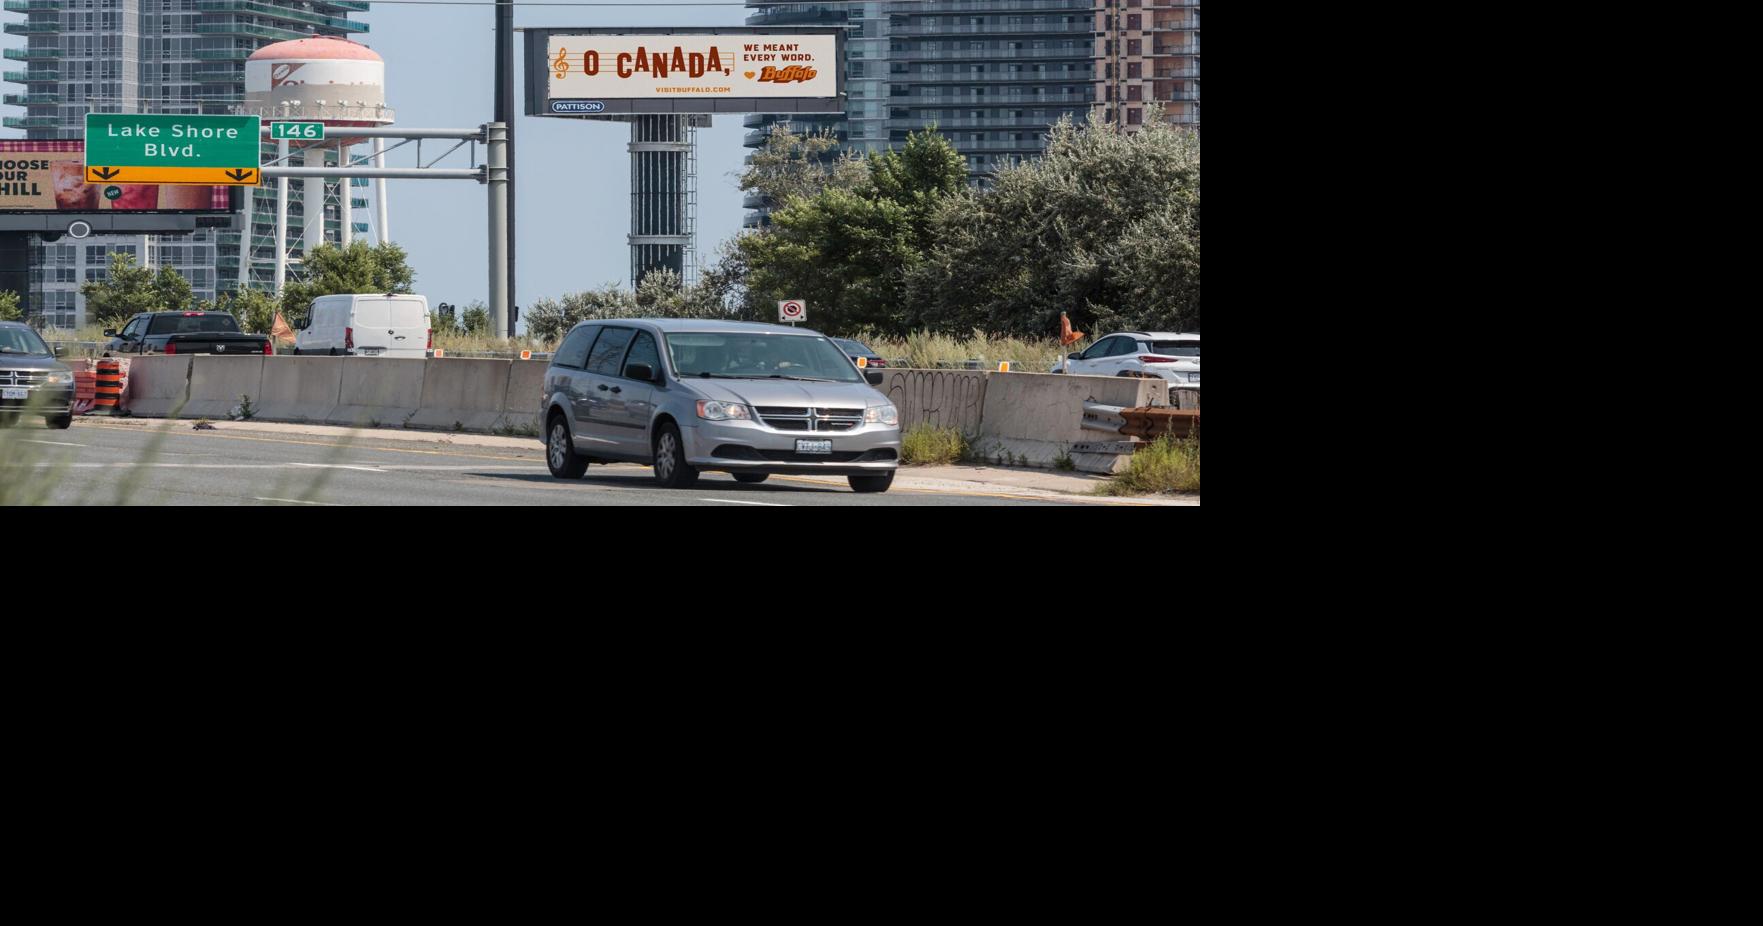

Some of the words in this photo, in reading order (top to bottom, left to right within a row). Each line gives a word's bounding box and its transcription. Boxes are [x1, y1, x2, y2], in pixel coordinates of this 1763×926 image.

[583, 50, 599, 76] O
[617, 46, 730, 78] CANADA,
[758, 65, 817, 83] Buffalo
[108, 123, 160, 137] Lake
[171, 124, 238, 138] Shore
[278, 124, 316, 137] 146
[144, 143, 201, 157] Blvd.
[0, 160, 49, 170] OOSE
